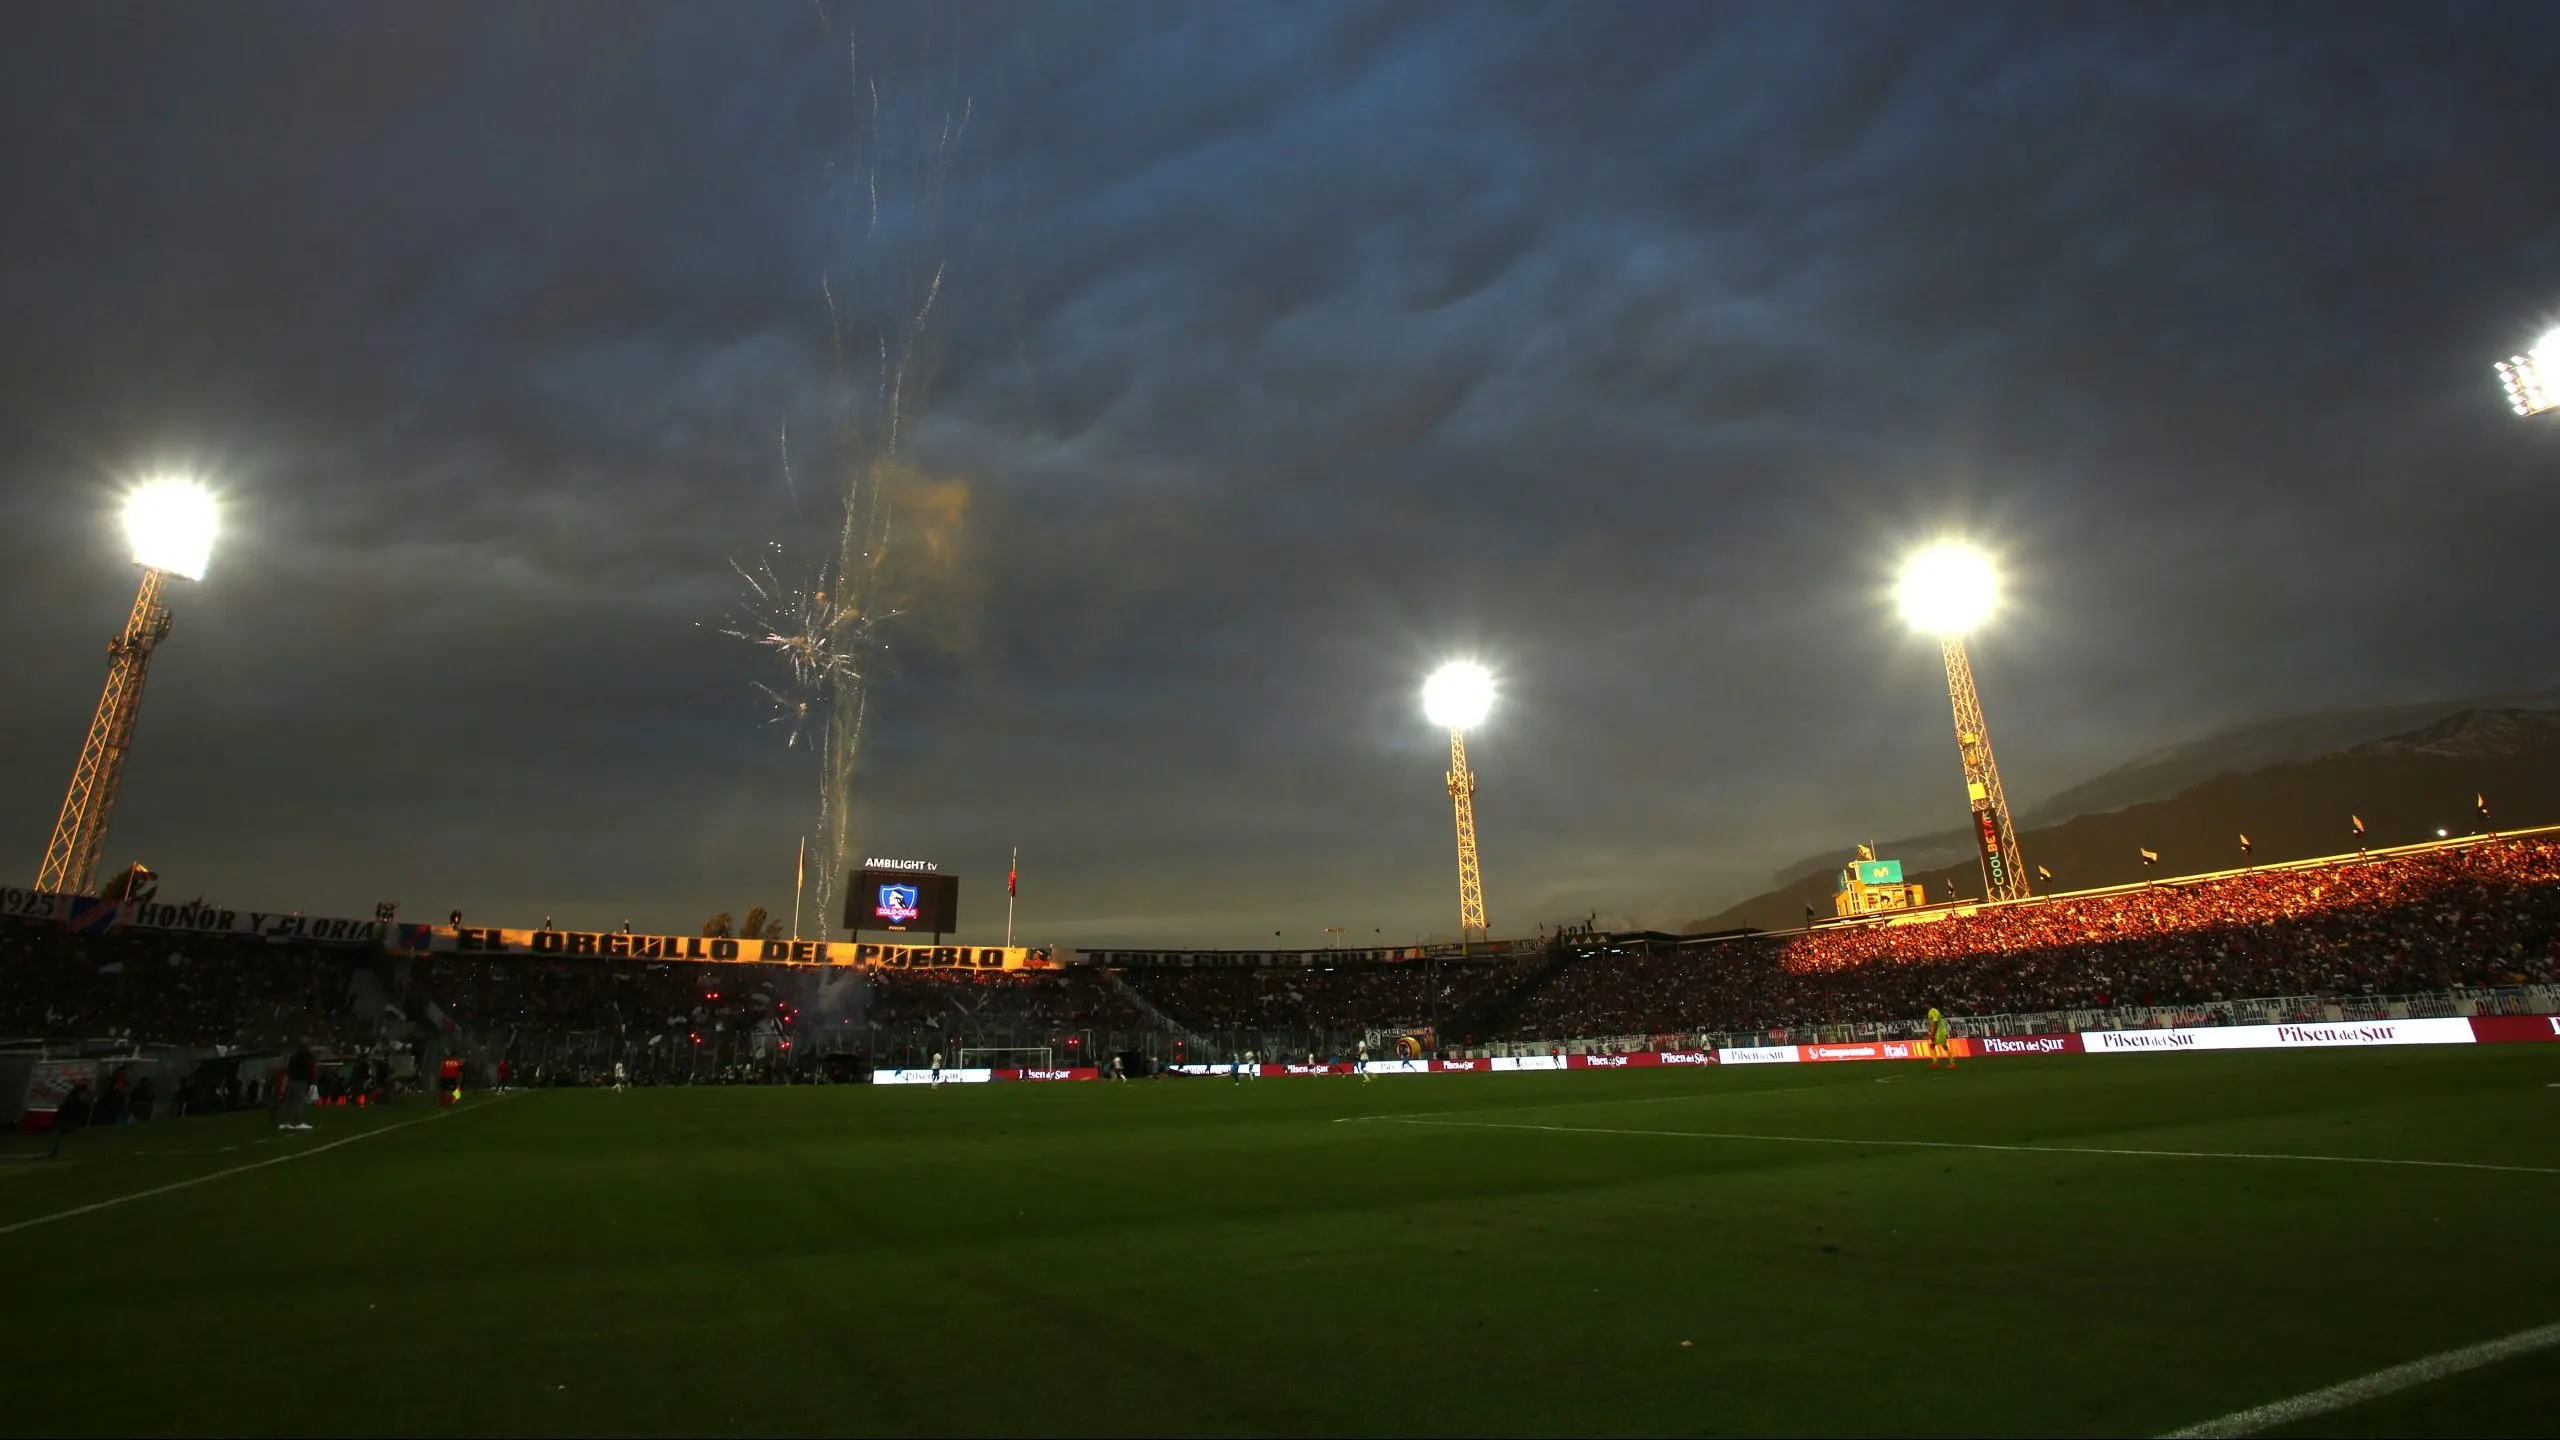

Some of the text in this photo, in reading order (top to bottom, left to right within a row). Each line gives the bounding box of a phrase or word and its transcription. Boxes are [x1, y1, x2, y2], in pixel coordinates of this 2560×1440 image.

[865, 857, 938, 871] AMBILIGHT tv
[879, 908, 916, 916] COLO-COLO
[136, 902, 236, 930] HONOR
[251, 912, 267, 932] Y
[277, 915, 376, 940] GLORIA
[456, 927, 1003, 969] EL ORGULLO DEL PUEBLO
[2103, 1034, 2195, 1047] Pilsen del Sur
[2278, 1027, 2395, 1042] Pilsen del Sur
[1983, 1039, 2064, 1052] Pilsen del Sur
[1587, 1055, 1608, 1066] Pilsen
[1661, 1052, 1686, 1063] Pilsen
